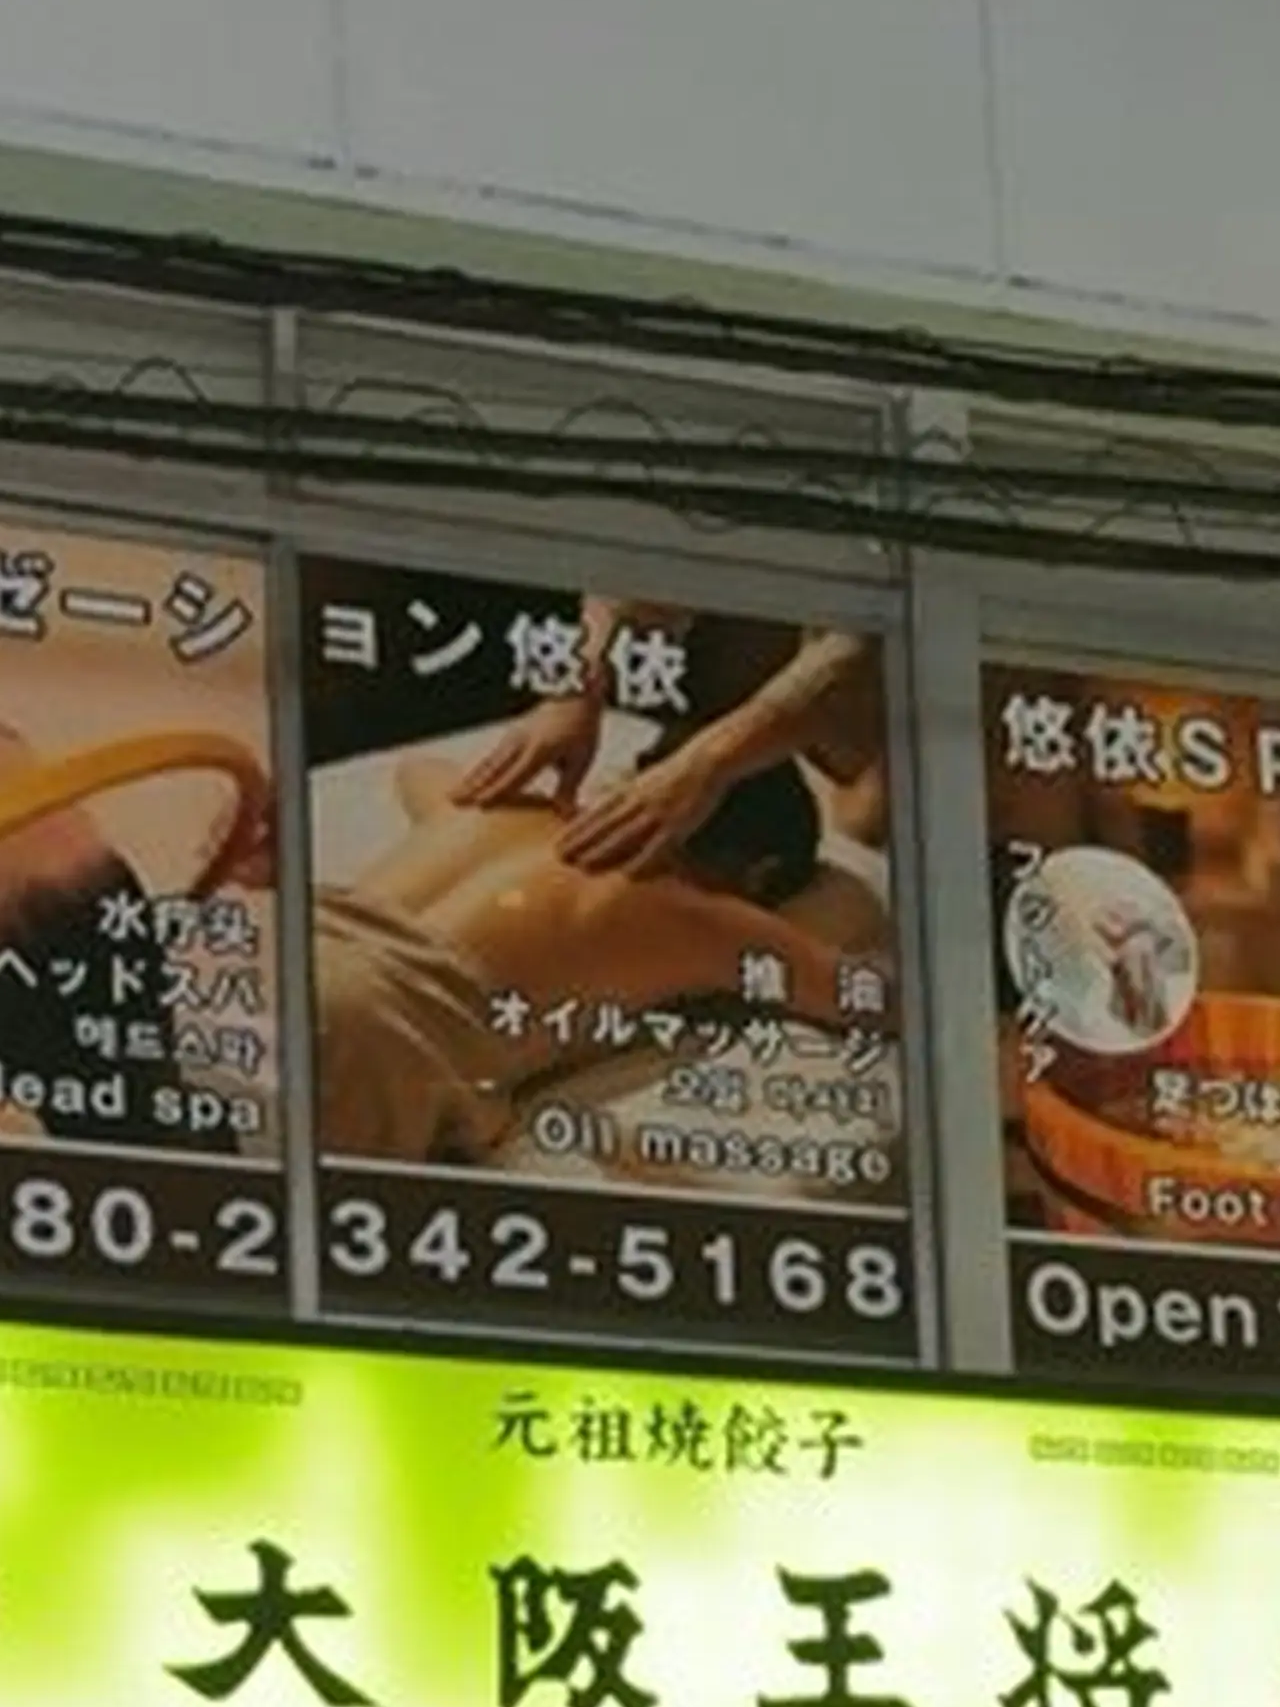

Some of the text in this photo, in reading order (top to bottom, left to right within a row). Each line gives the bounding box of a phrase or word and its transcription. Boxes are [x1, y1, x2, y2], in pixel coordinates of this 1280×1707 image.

[490, 990, 884, 1072] オイルマッサージ
[152, 1086, 261, 1133] spa
[534, 1106, 891, 1183] Oil massage
[1148, 1178, 1268, 1226] Foot
[490, 1391, 865, 1480] 元祖焼餃子
